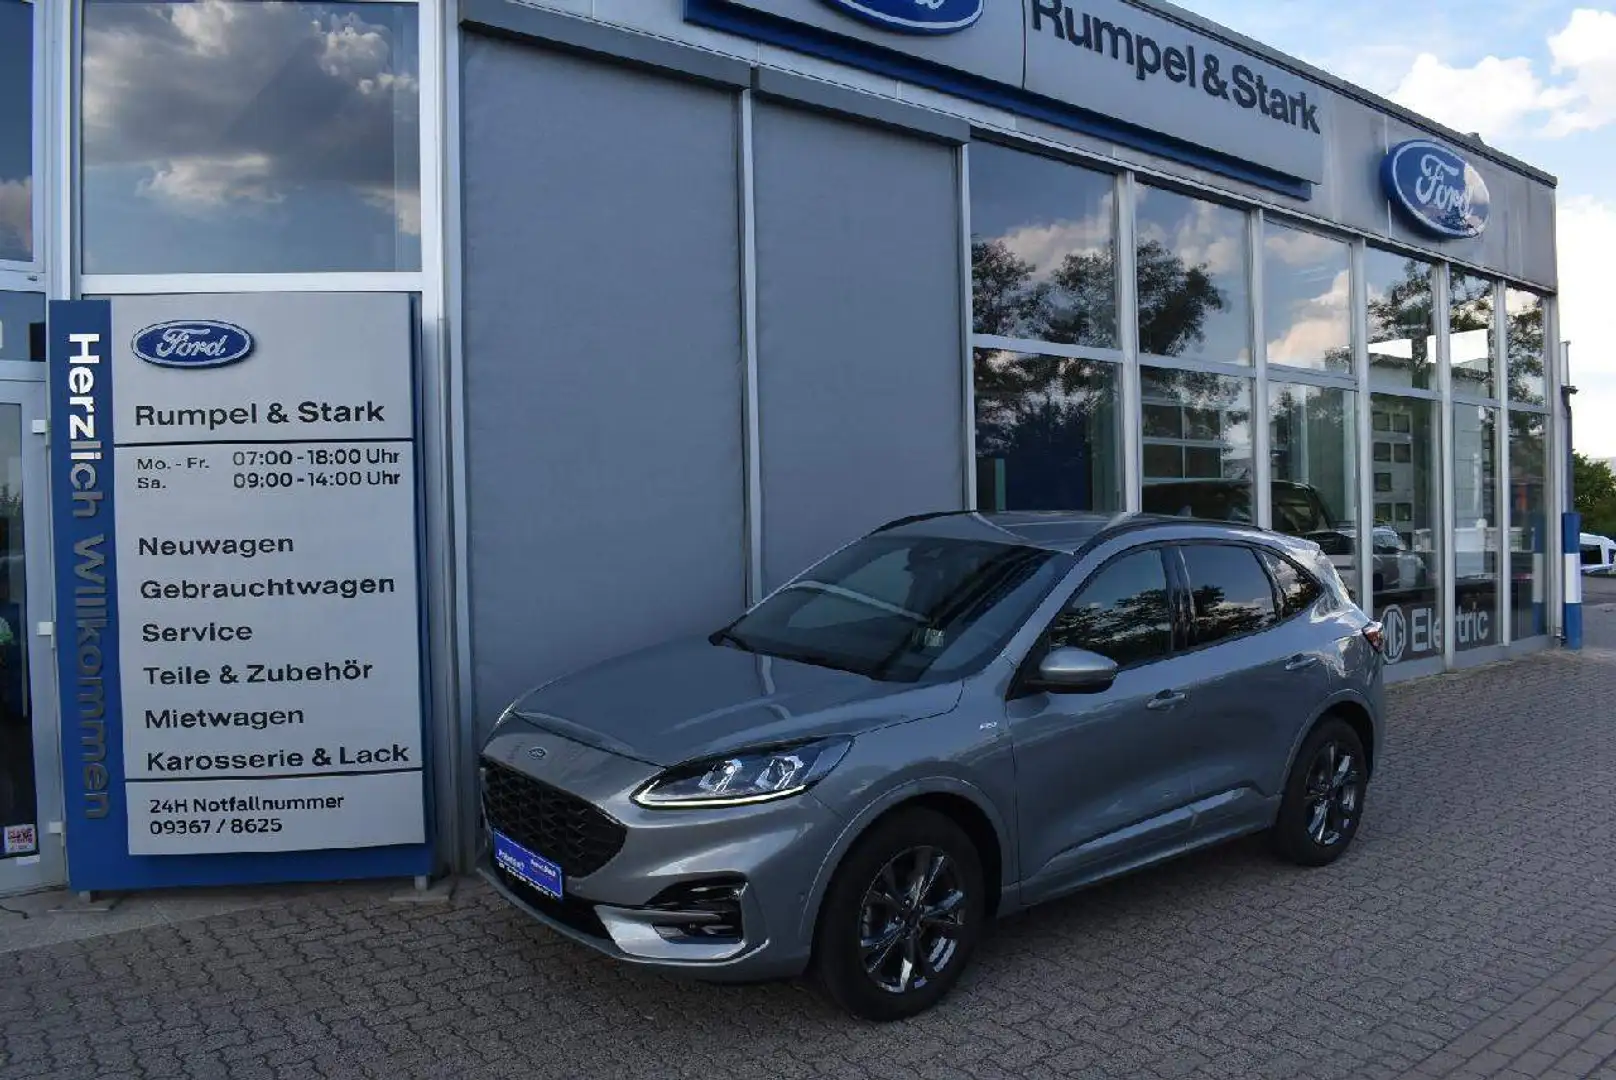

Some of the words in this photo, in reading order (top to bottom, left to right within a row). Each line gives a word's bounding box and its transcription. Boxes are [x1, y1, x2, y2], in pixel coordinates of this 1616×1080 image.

[1032, 0, 1196, 88] Rumpel
[1202, 53, 1230, 100] &
[1232, 64, 1321, 134] Stark
[1415, 154, 1474, 220] Ford
[155, 328, 228, 358] Ford
[68, 333, 104, 518] Herzlich
[135, 402, 258, 431] Rumpel
[266, 402, 290, 425] &
[298, 400, 385, 424] Stark
[137, 458, 171, 470] Mo.
[187, 457, 210, 469] Fr.
[366, 448, 400, 465] Uhr
[137, 477, 167, 489] Sa.
[367, 469, 401, 486] Uhr
[139, 536, 294, 559] Neuwagen
[140, 577, 395, 600] Gebrauchtwagen
[142, 623, 253, 643] Service
[1412, 602, 1489, 651] Eletric
[73, 534, 111, 819] Willkommen
[143, 666, 211, 685] Teile
[219, 665, 240, 685] &
[247, 659, 373, 684] Zubehör
[145, 708, 304, 730] Mietwagen
[147, 751, 304, 772] Karosserie
[312, 747, 332, 767] &
[339, 744, 410, 765] Lack
[149, 798, 188, 814] 24H
[193, 796, 345, 813] Notfallnummer
[150, 819, 211, 835] 09367
[215, 818, 226, 834] /
[230, 818, 283, 834] 8625
